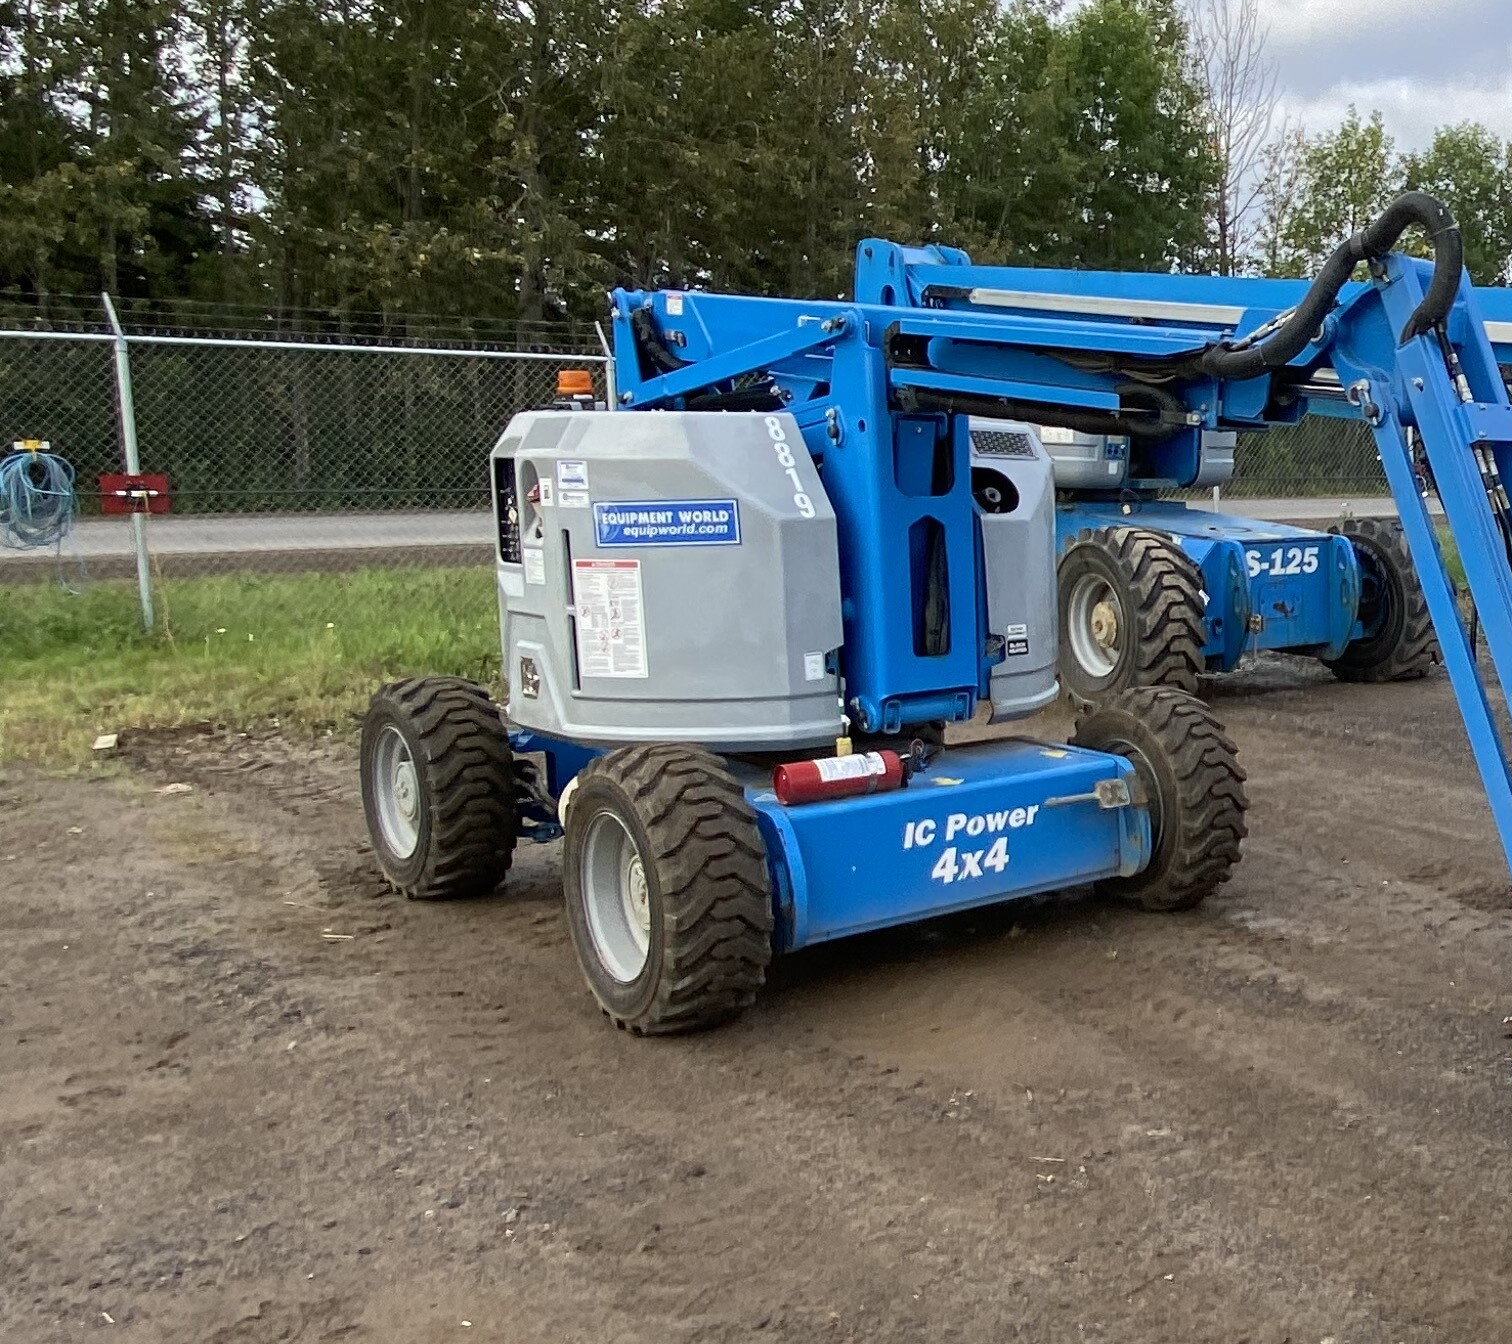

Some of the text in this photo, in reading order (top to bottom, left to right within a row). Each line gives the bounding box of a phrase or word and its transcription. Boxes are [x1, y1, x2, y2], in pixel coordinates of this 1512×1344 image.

[764, 416, 815, 519] 8819
[602, 509, 729, 525] EQUIPMENT WORLD
[623, 522, 729, 538] equipworld.com
[1245, 546, 1319, 577] S-125
[903, 804, 1039, 849] IC Power
[931, 837, 1010, 884] 4x4
